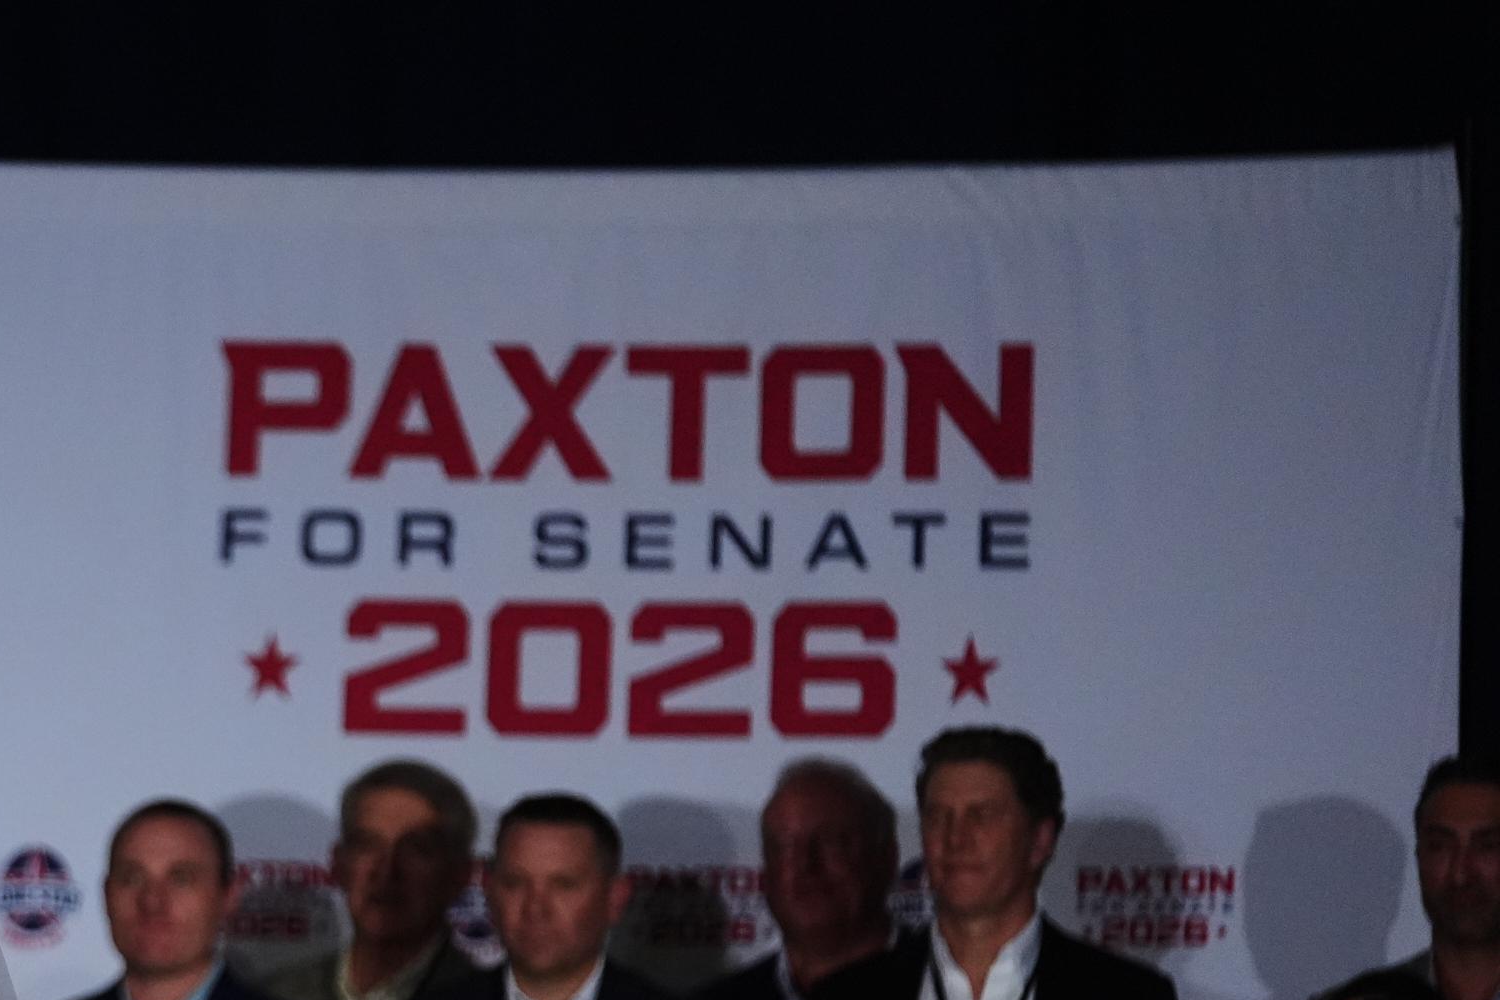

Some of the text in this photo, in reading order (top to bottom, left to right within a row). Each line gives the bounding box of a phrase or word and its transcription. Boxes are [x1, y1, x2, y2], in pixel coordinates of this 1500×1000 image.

[219, 338, 1035, 483] PAXTON
[219, 508, 1034, 572] FOR SENATE
[341, 596, 899, 739] 2026
[1076, 864, 1238, 899] PAXTON
[1101, 912, 1211, 949] 2026
